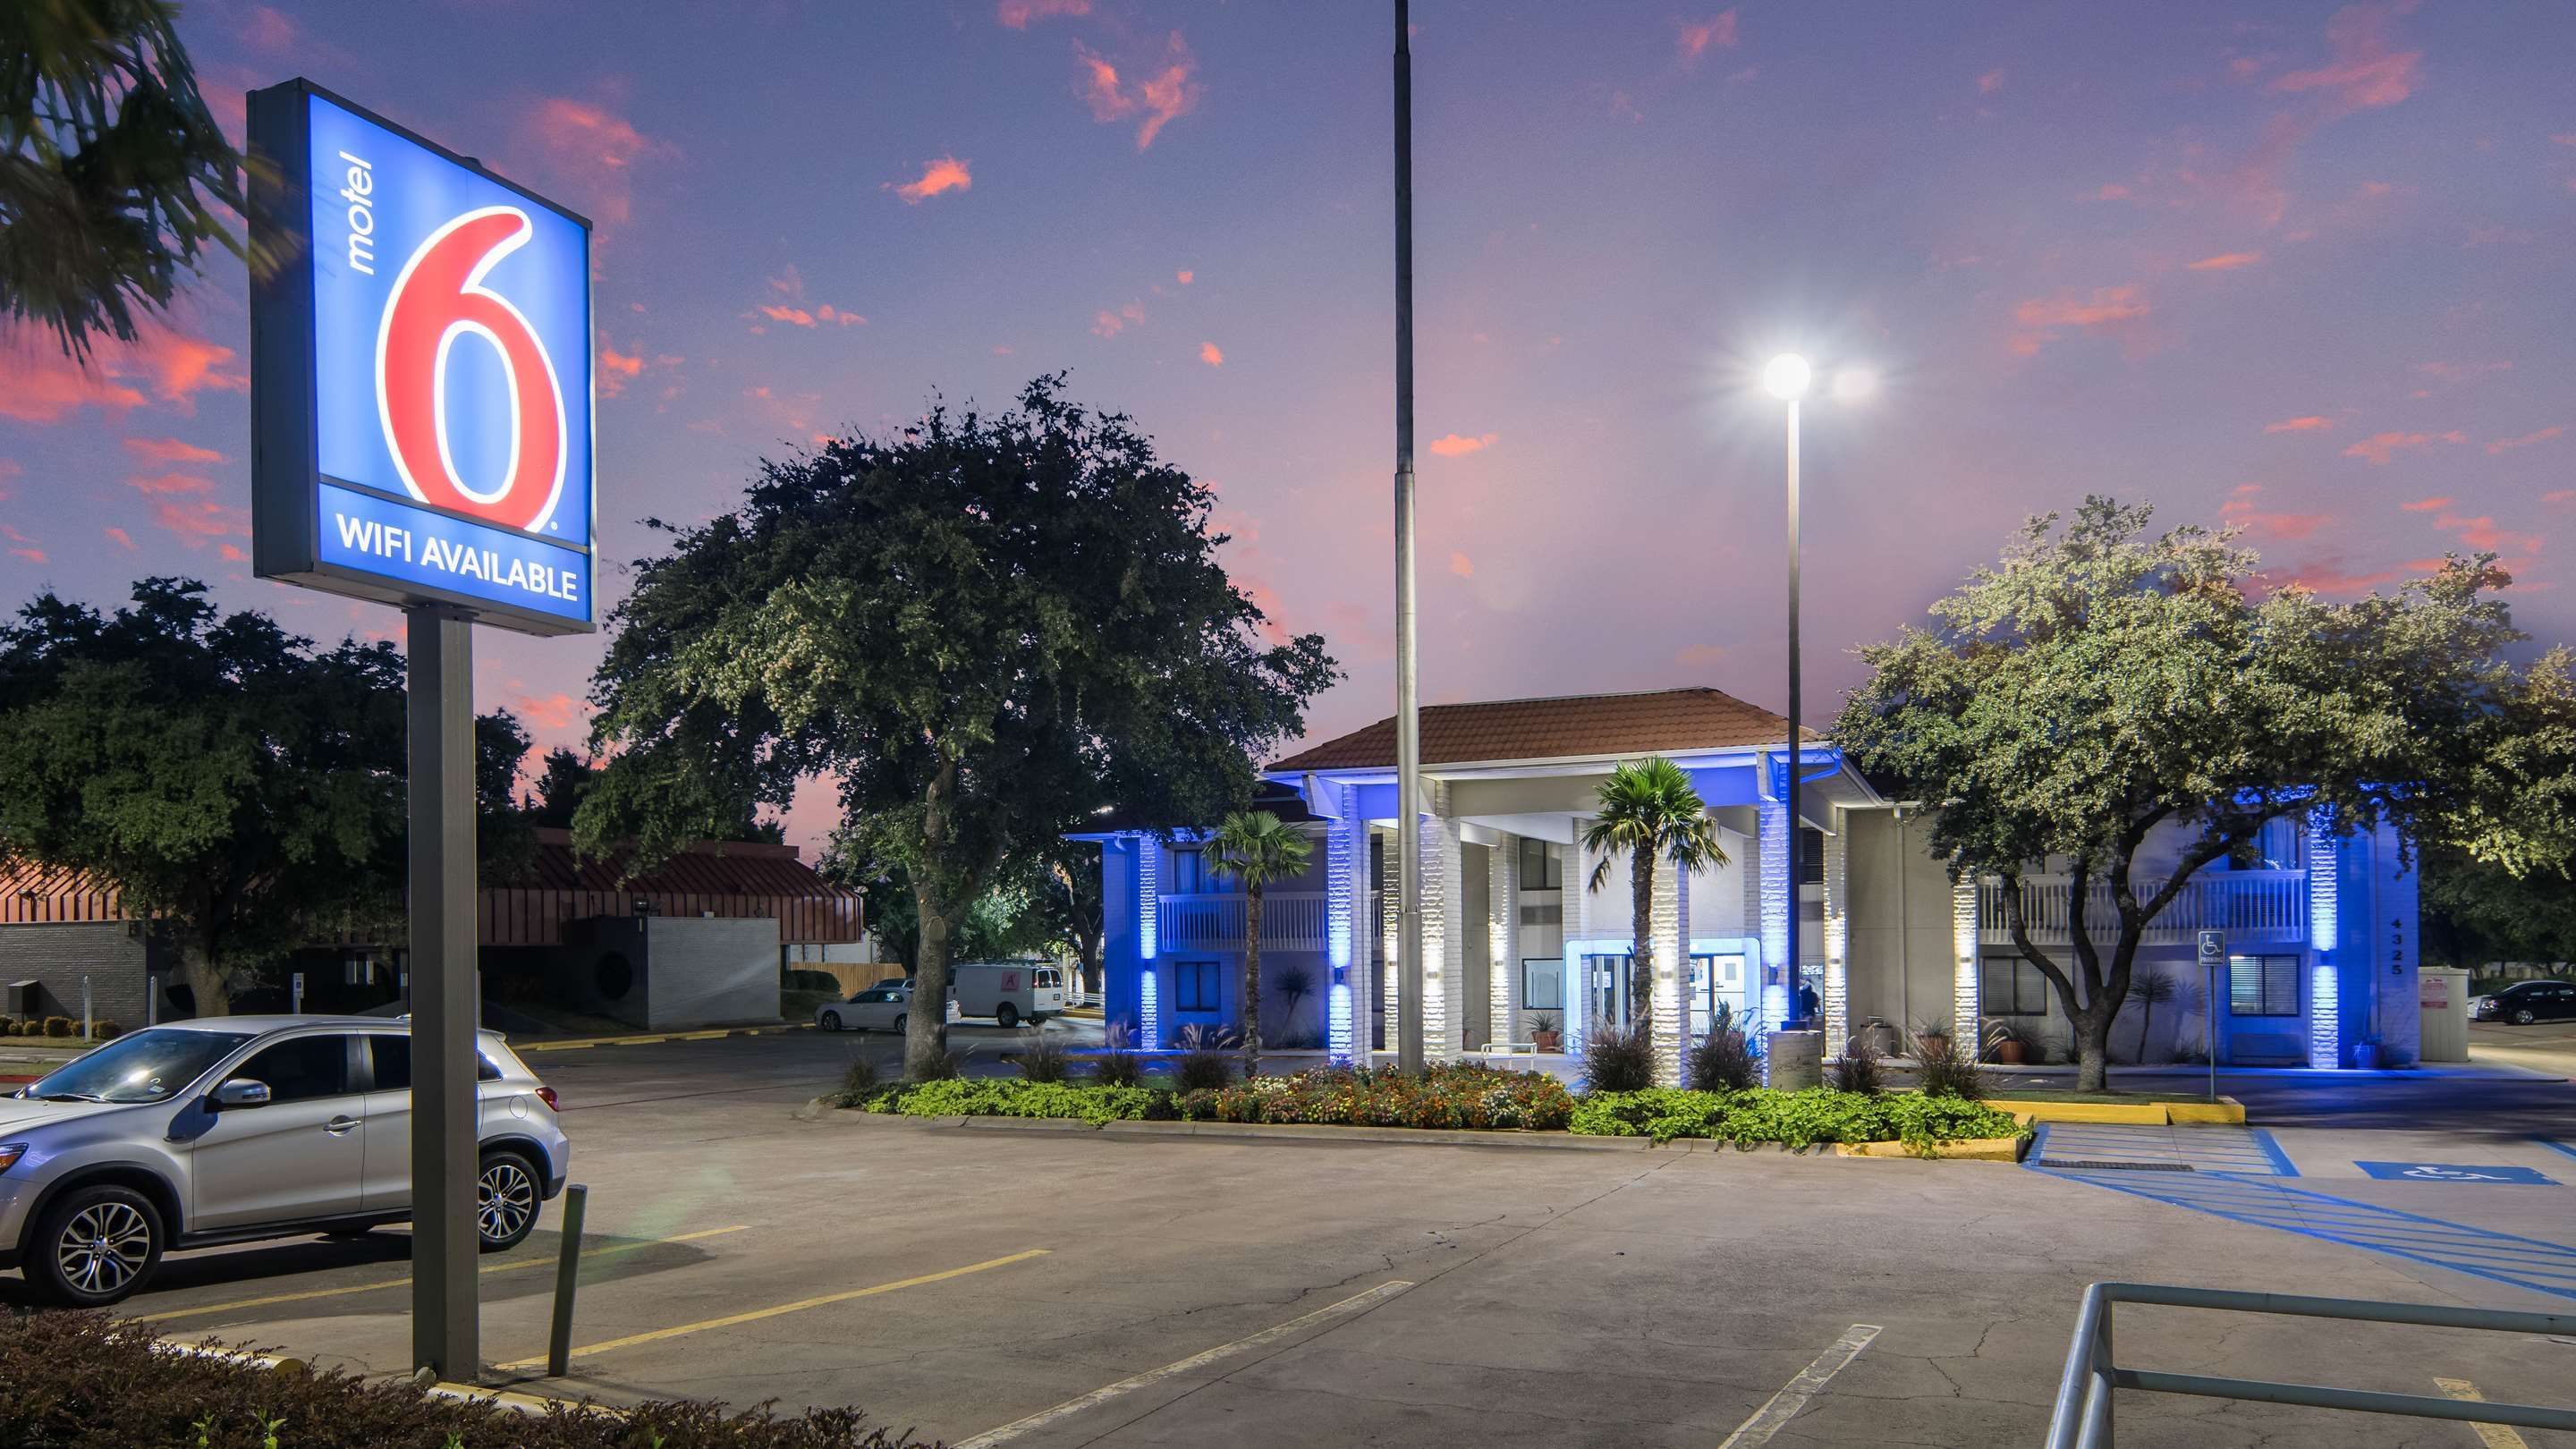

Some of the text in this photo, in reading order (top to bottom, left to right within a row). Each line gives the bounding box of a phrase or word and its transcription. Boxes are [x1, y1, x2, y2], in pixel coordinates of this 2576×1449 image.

[338, 150, 375, 275] motel
[376, 206, 567, 533] 6
[335, 513, 578, 602] WIFI AVAILABLE
[2391, 918, 2403, 975] 4325
